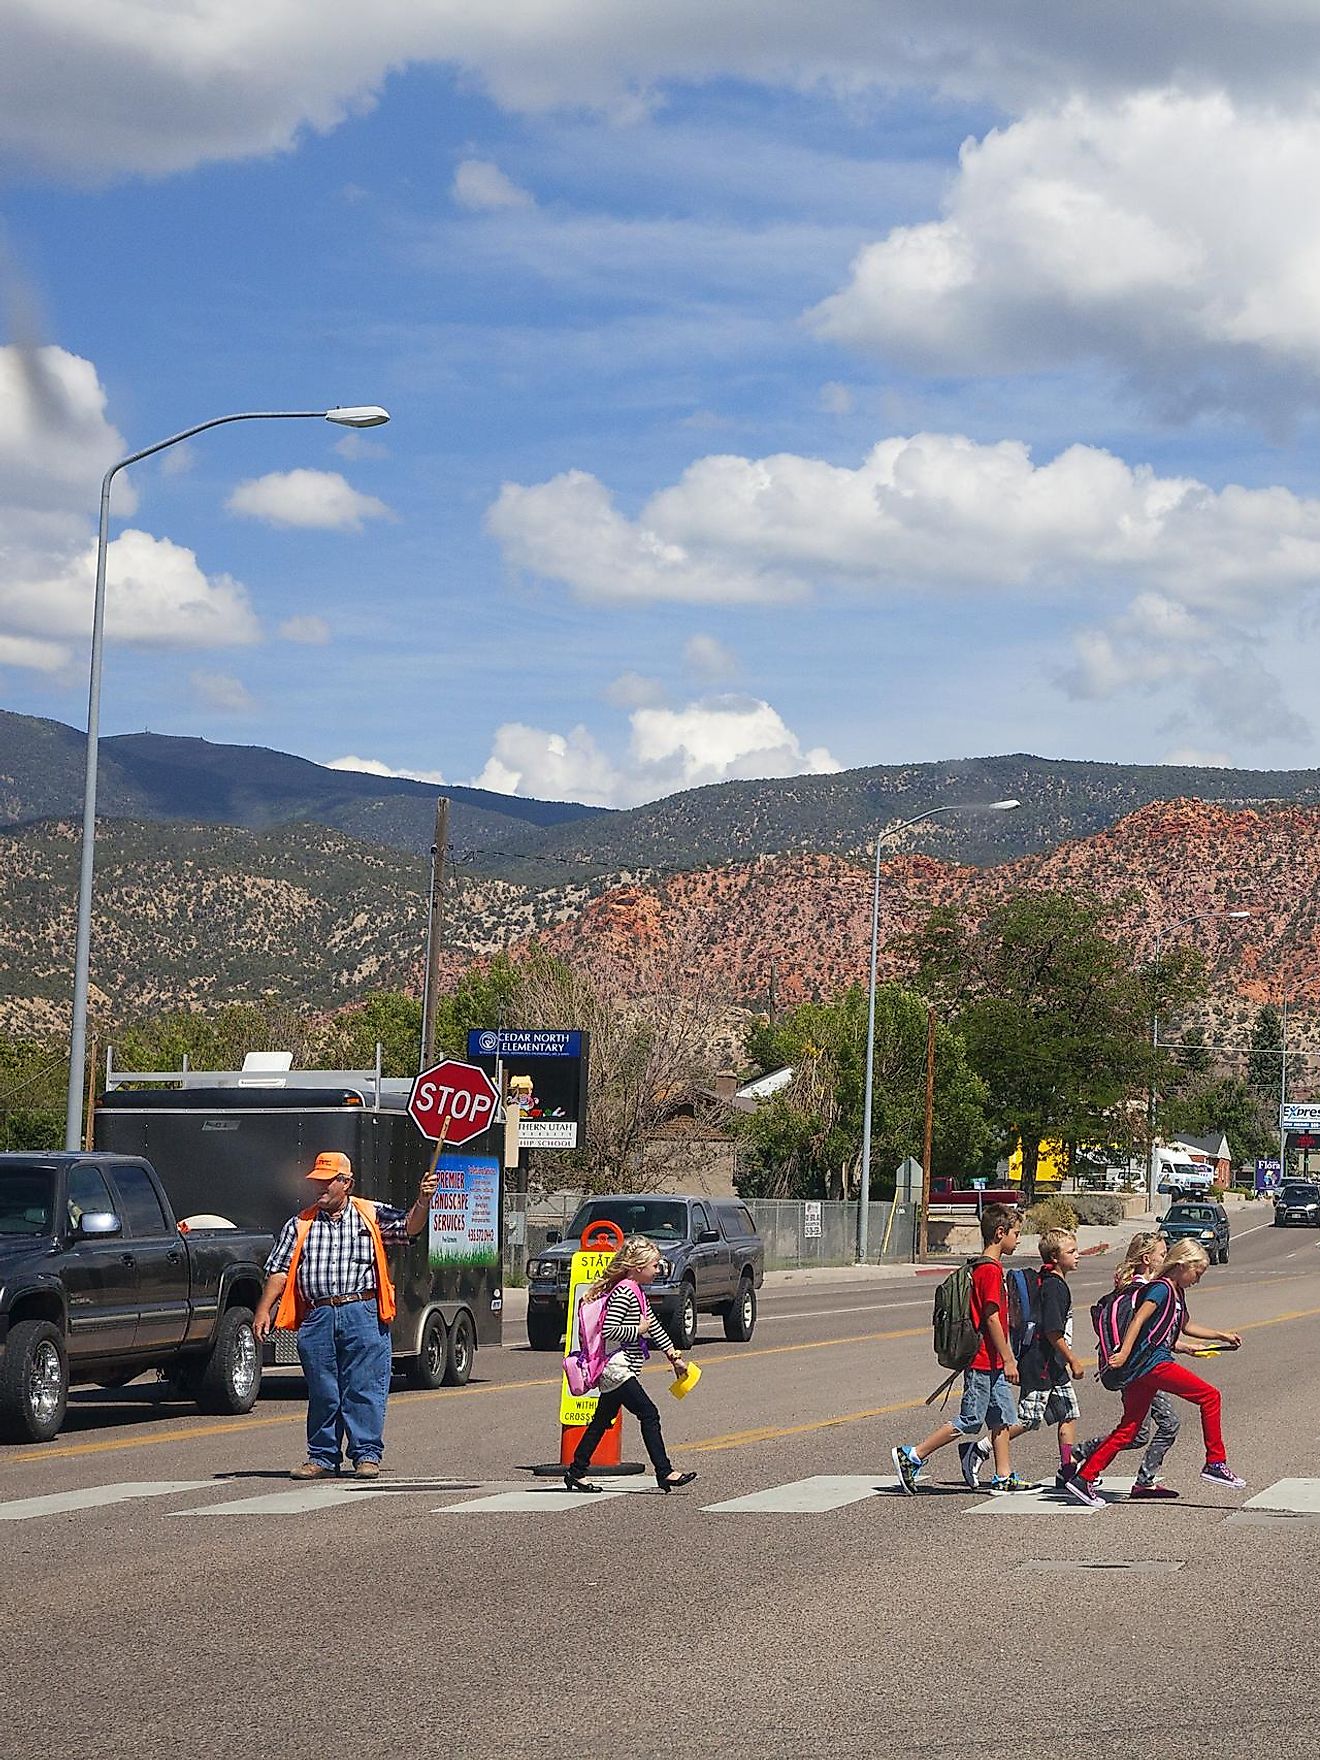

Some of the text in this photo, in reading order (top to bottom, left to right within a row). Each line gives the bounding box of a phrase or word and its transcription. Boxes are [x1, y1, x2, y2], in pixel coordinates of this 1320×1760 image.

[499, 1033, 570, 1043] CEDAR NORTH
[502, 1042, 565, 1052] ELEMENTARY
[415, 1082, 491, 1122] STOP
[1258, 1160, 1281, 1170] Flora
[436, 1171, 465, 1189] PREMIER
[431, 1192, 469, 1210] LANDSCAPE
[433, 1213, 466, 1232] SERVICES
[581, 1256, 613, 1267] STAT
[586, 1269, 606, 1280] LA
[576, 1401, 597, 1410] WITHI
[564, 1412, 592, 1421] CROSS
